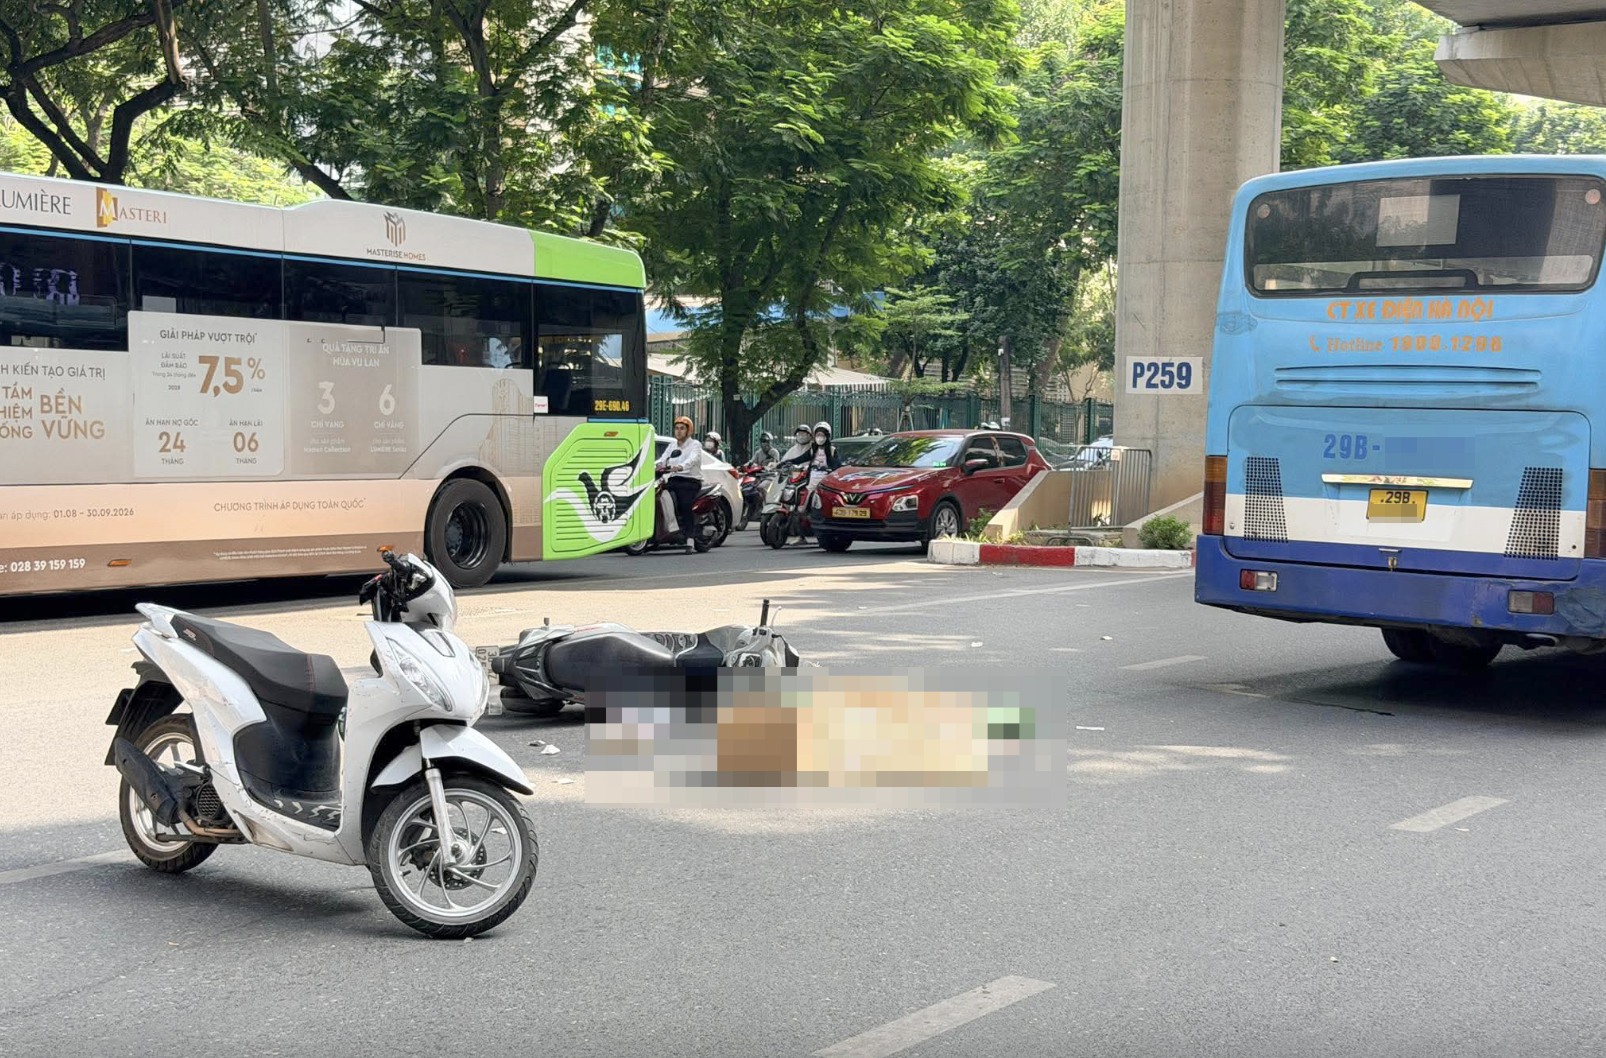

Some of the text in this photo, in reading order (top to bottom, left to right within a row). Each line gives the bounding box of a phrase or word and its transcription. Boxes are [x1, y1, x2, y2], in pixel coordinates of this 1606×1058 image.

[0, 188, 71, 215] UMIÈRE
[99, 199, 167, 223] MASTERI
[366, 248, 426, 261] MASTERISE HOMES
[1327, 301, 1350, 319] CT
[1354, 301, 1376, 319] XE
[159, 327, 180, 340] GIẢI
[181, 329, 206, 341] PHÁP
[1327, 336, 1383, 353] Hotline
[12, 361, 39, 376] KIẾN
[41, 365, 65, 380] TẠO
[67, 364, 87, 378] GIÁ
[88, 367, 106, 381] TRỊ
[364, 359, 381, 368] LAN
[1132, 361, 1192, 389] P259
[1, 381, 33, 400] TẤM
[317, 381, 336, 415] 3
[379, 384, 396, 416] 6
[40, 387, 83, 415] BỀN
[41, 415, 106, 440] VỮNG
[158, 431, 186, 453] 24
[233, 431, 259, 453] 06
[11, 510, 23, 521] áp
[53, 509, 77, 518] 01.08
[87, 508, 134, 517] 30.09.2026
[253, 498, 279, 511] TRÌNH
[279, 500, 291, 510] ÁP
[292, 501, 316, 512] DỤNG
[317, 499, 339, 509] TOÀN
[10, 561, 31, 573] 028
[33, 560, 47, 571] 39
[48, 559, 67, 570] 159
[68, 558, 86, 569] 159
